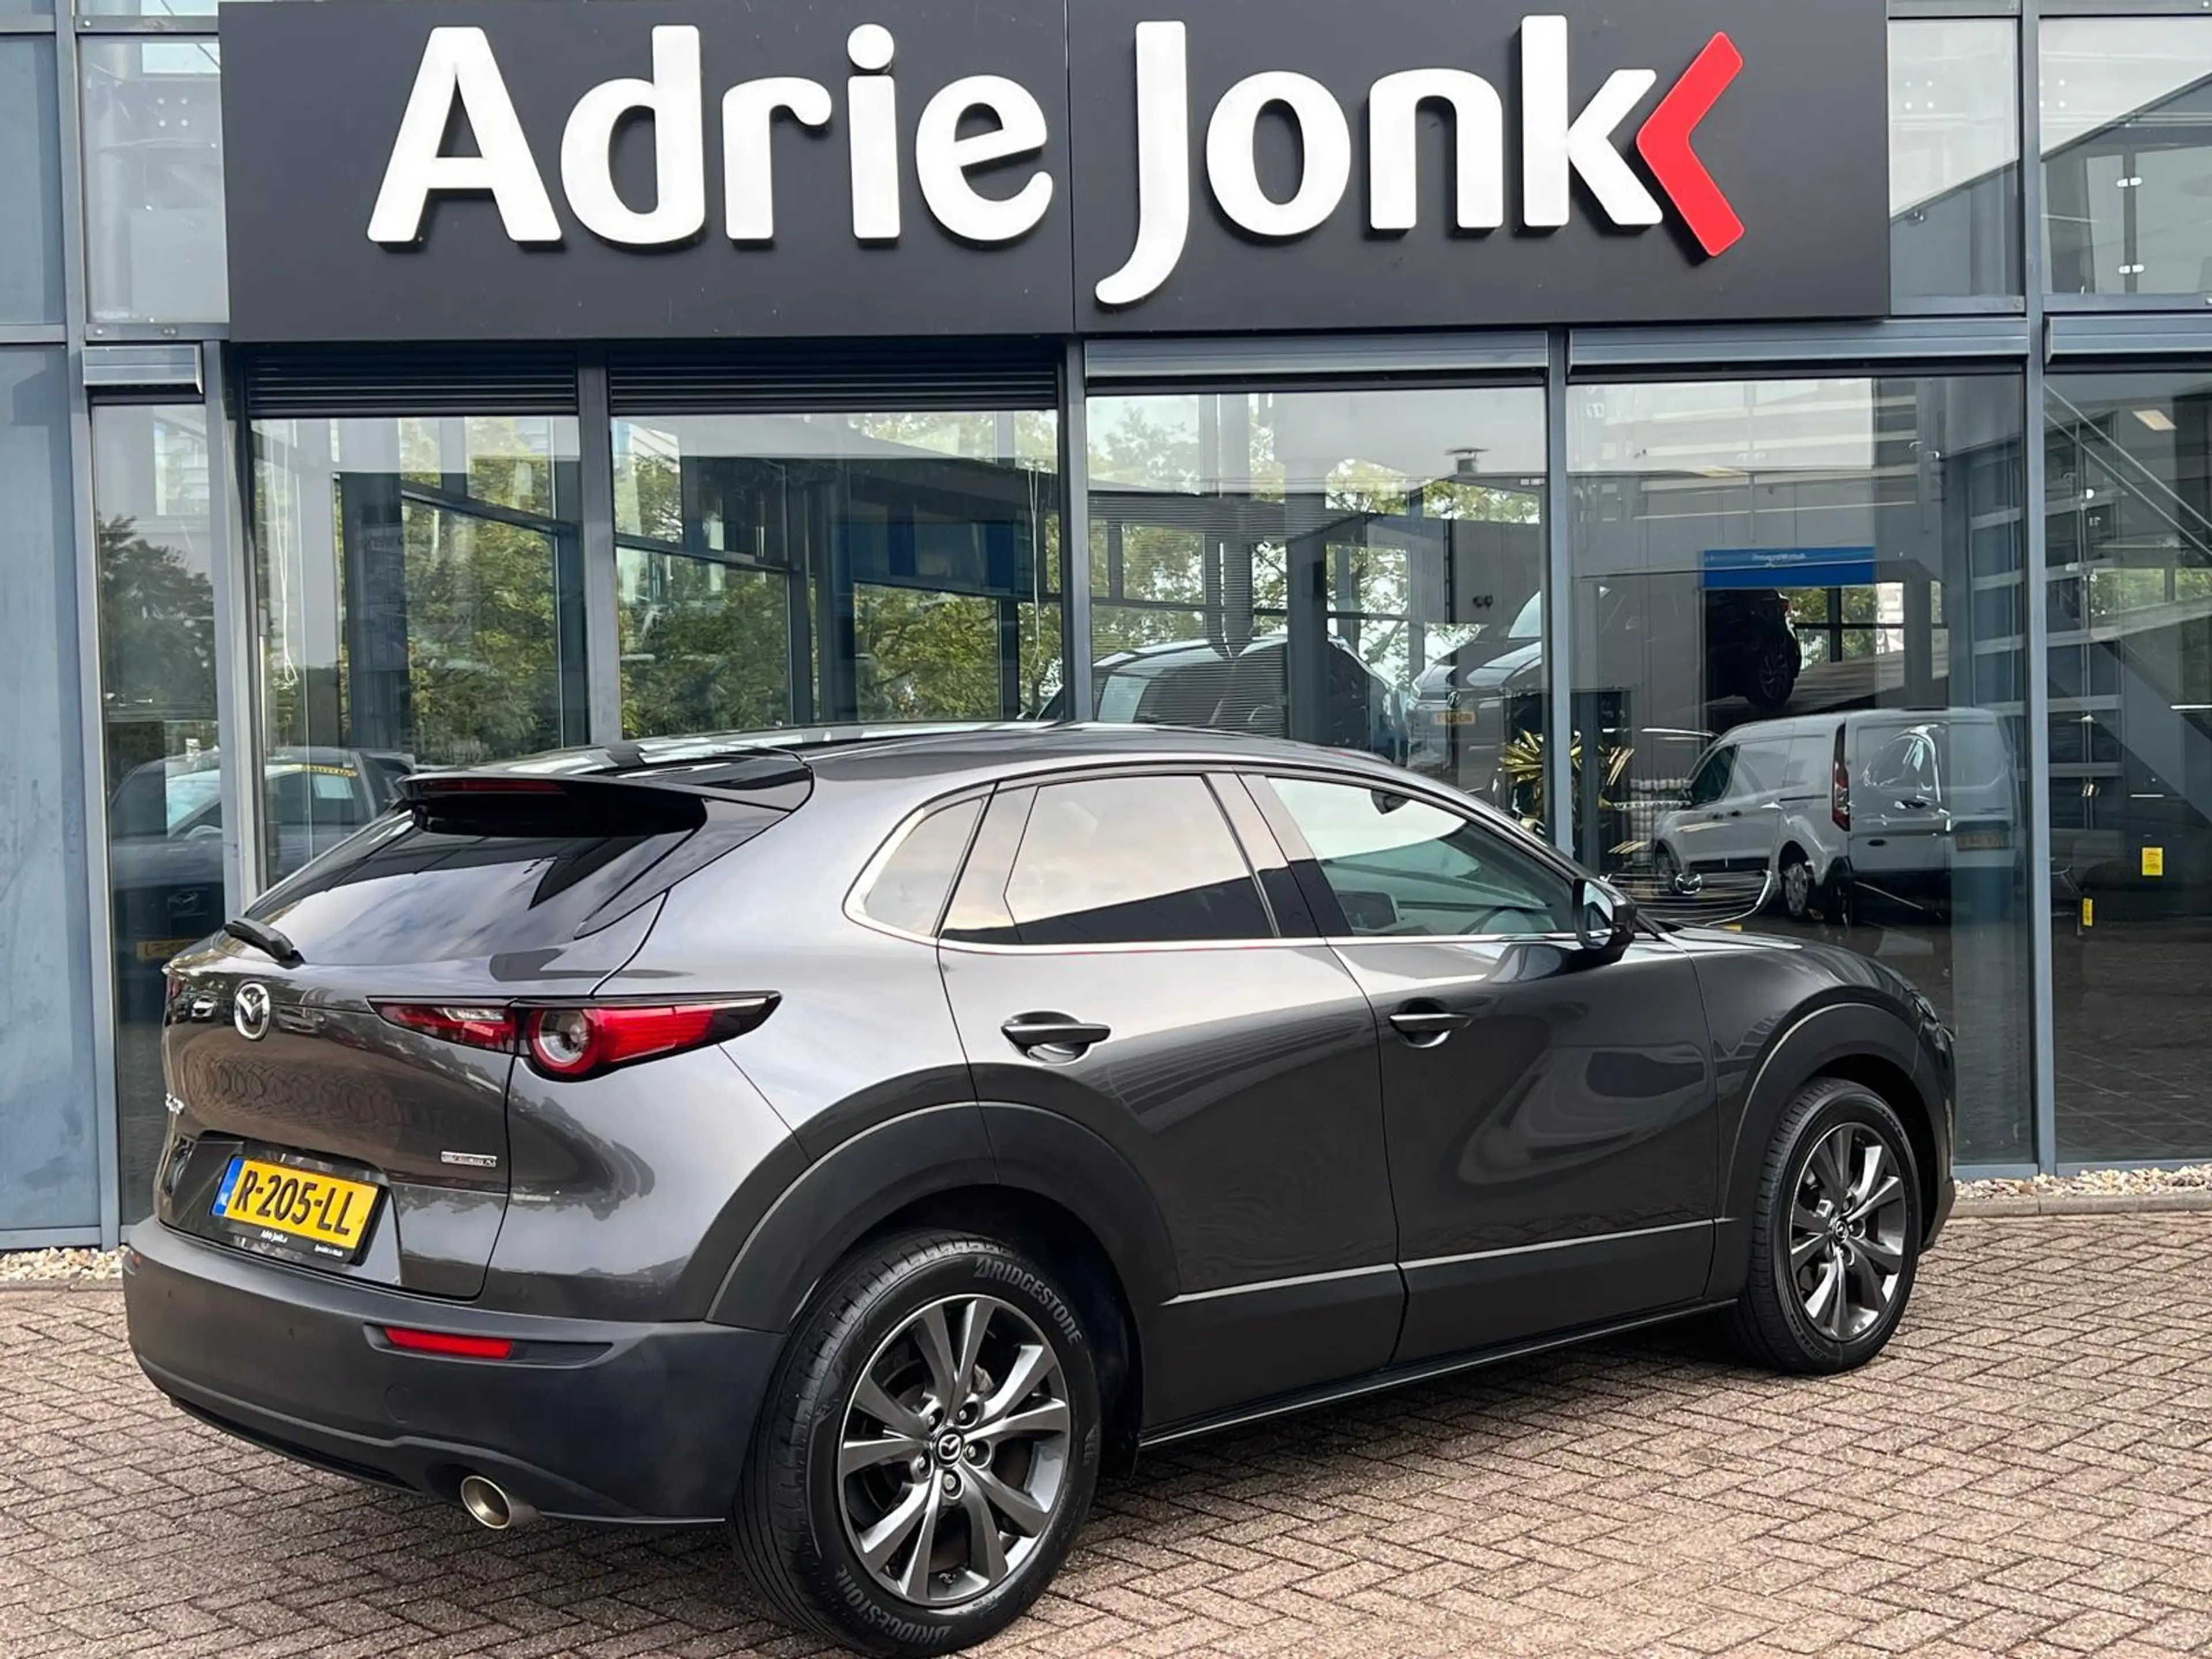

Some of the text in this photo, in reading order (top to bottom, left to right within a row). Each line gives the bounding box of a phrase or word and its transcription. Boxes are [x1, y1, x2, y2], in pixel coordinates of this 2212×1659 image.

[367, 14, 1664, 305] Adrie Jonk
[234, 1169, 354, 1236] R-205-LL
[974, 1256, 1083, 1347] BRIDGESTONE
